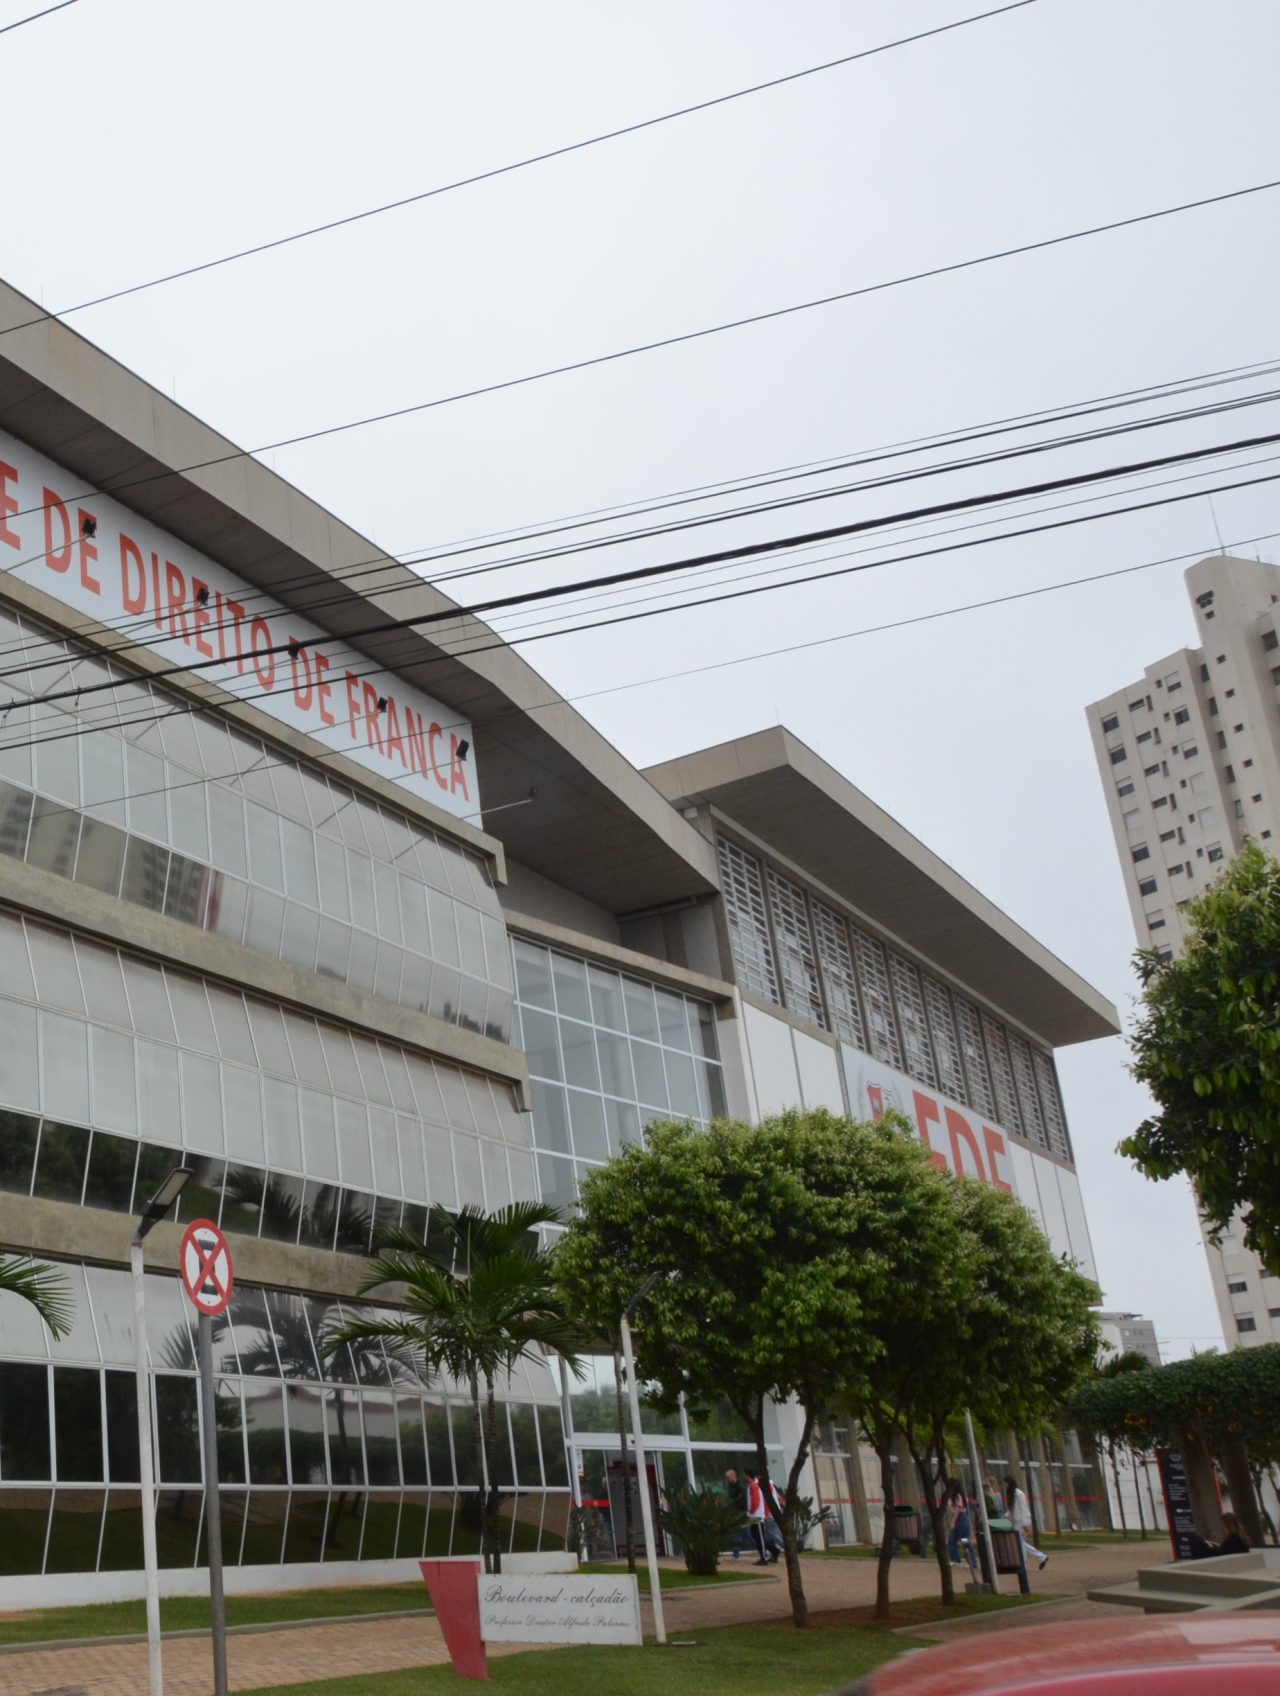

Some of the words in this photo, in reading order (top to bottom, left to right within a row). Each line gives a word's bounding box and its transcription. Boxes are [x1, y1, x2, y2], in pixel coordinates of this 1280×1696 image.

[42, 485, 101, 597] DE
[119, 531, 276, 692] DIREITO
[288, 635, 336, 728] DE
[345, 669, 470, 803] FRANCA
[483, 1584, 564, 1604] Boulevard
[570, 1588, 628, 1609] calçadão
